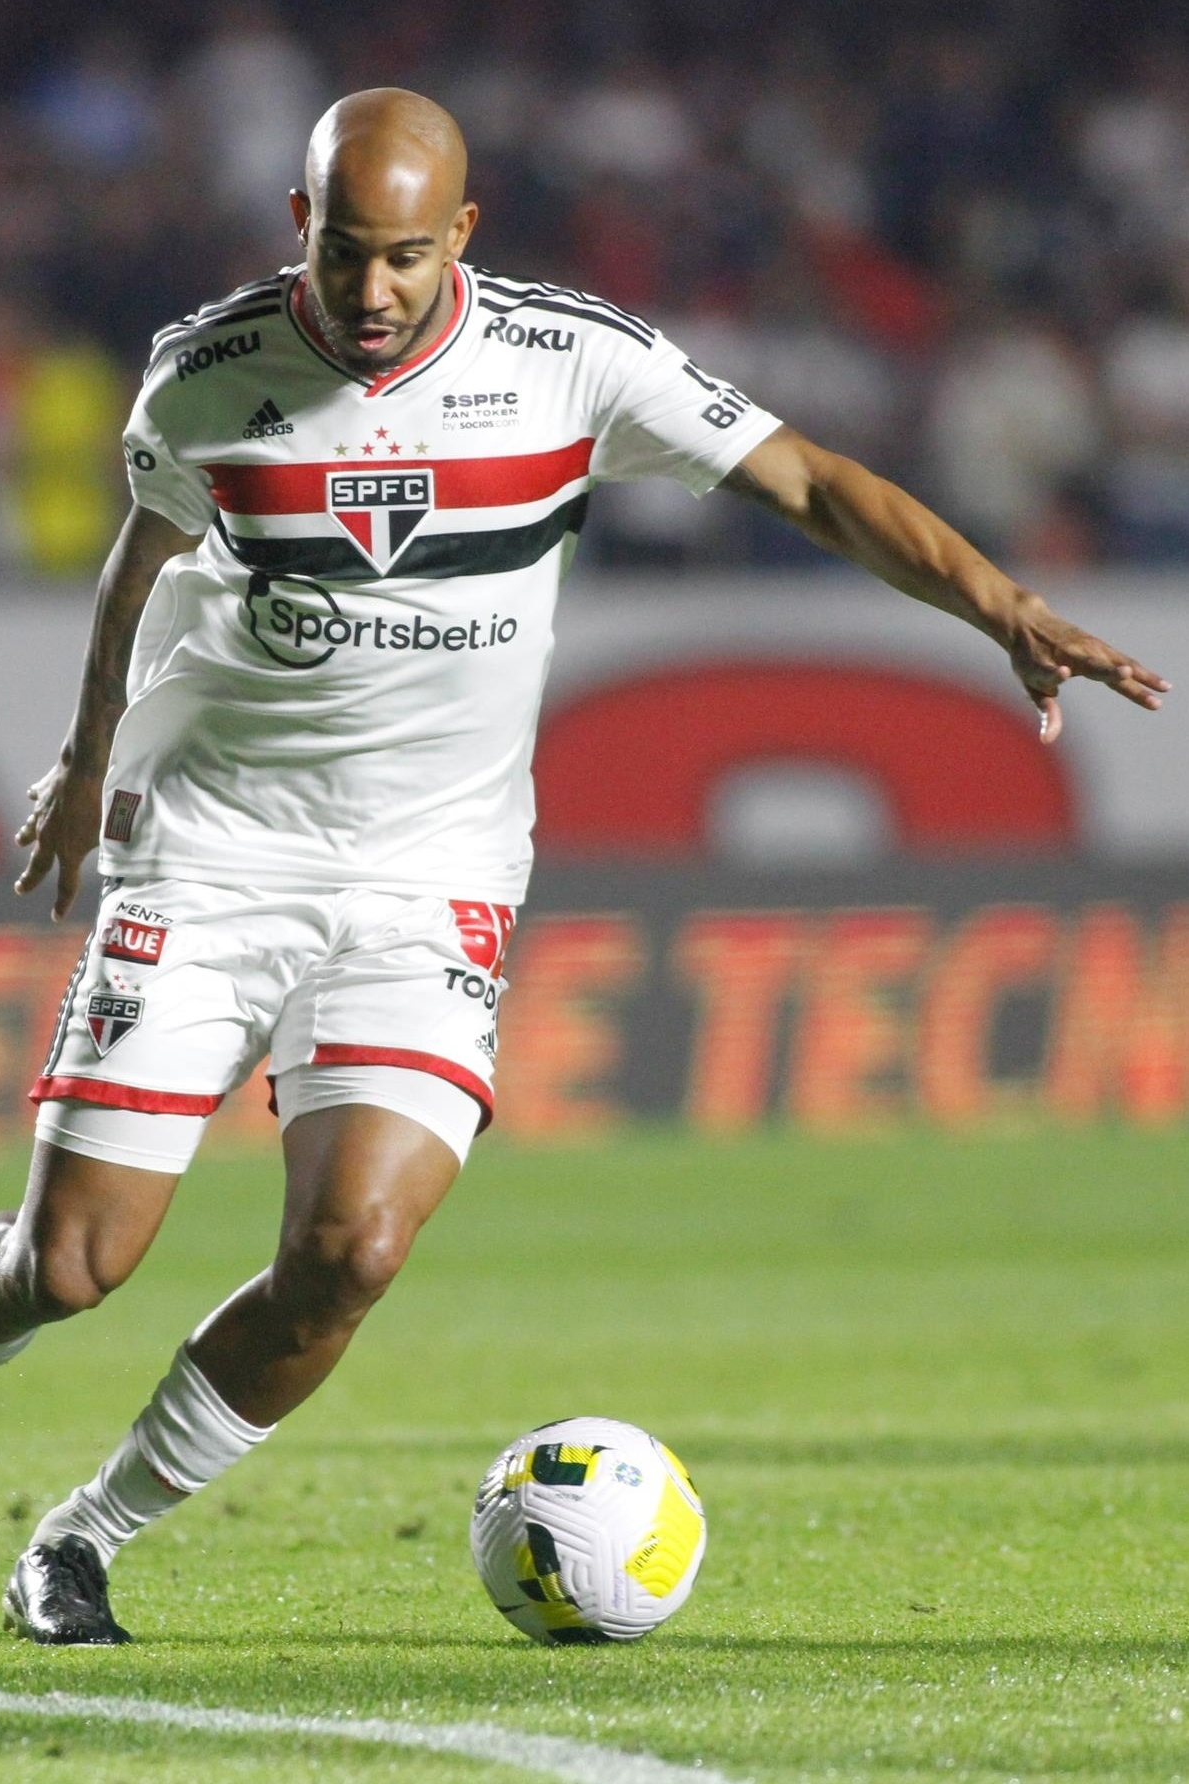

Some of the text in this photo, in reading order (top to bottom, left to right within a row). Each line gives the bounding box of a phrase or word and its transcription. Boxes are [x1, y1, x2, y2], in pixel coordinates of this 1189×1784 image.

[442, 392, 518, 409] $SPFC
[442, 408, 518, 419] FAN TOKEN
[242, 421, 294, 440] adidas
[442, 420, 456, 431] by
[334, 478, 425, 503] SPFC
[269, 597, 518, 652] Sportsbet.io
[89, 999, 138, 1016] SPFC
